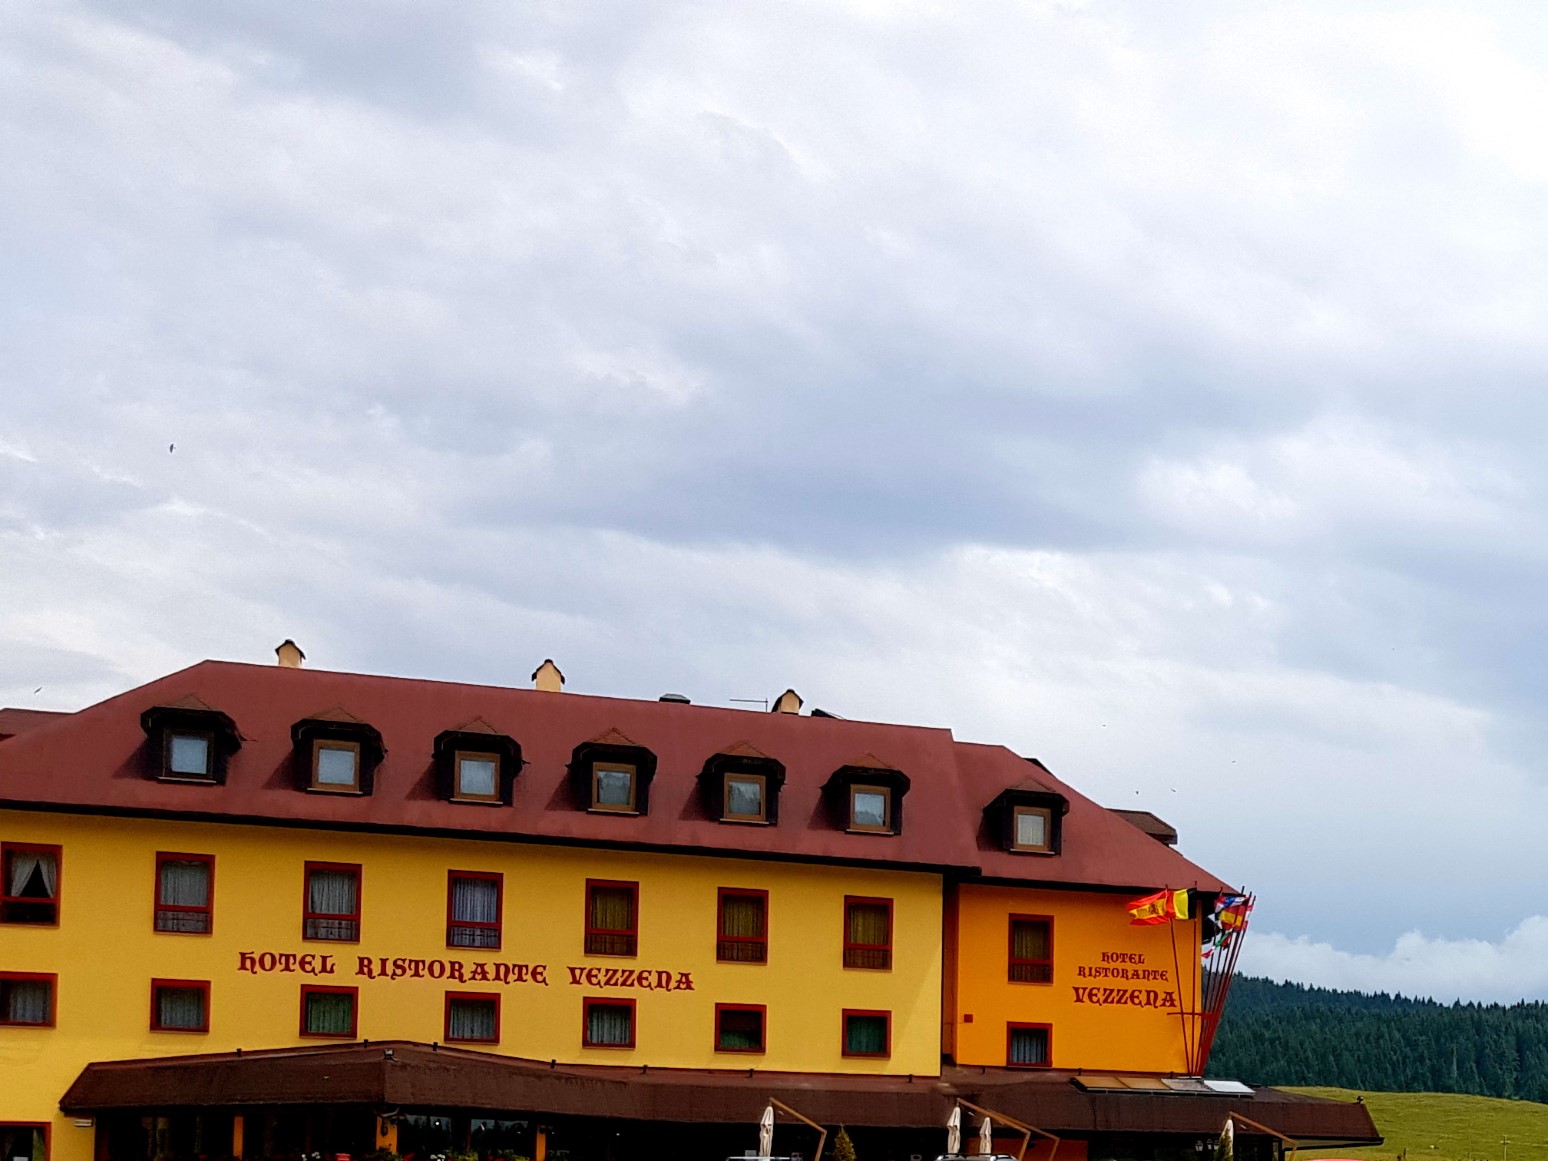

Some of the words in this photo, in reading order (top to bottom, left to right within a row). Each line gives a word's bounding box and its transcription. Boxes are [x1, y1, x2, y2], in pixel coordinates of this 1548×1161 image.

[1101, 951, 1145, 965] HOTEL
[238, 951, 336, 975] HOTEL
[355, 955, 549, 986] RISTORANTE
[566, 965, 695, 991] VEZZENA
[1077, 966, 1169, 982] RISTORANTE
[1072, 986, 1178, 1009] VEZZENA
